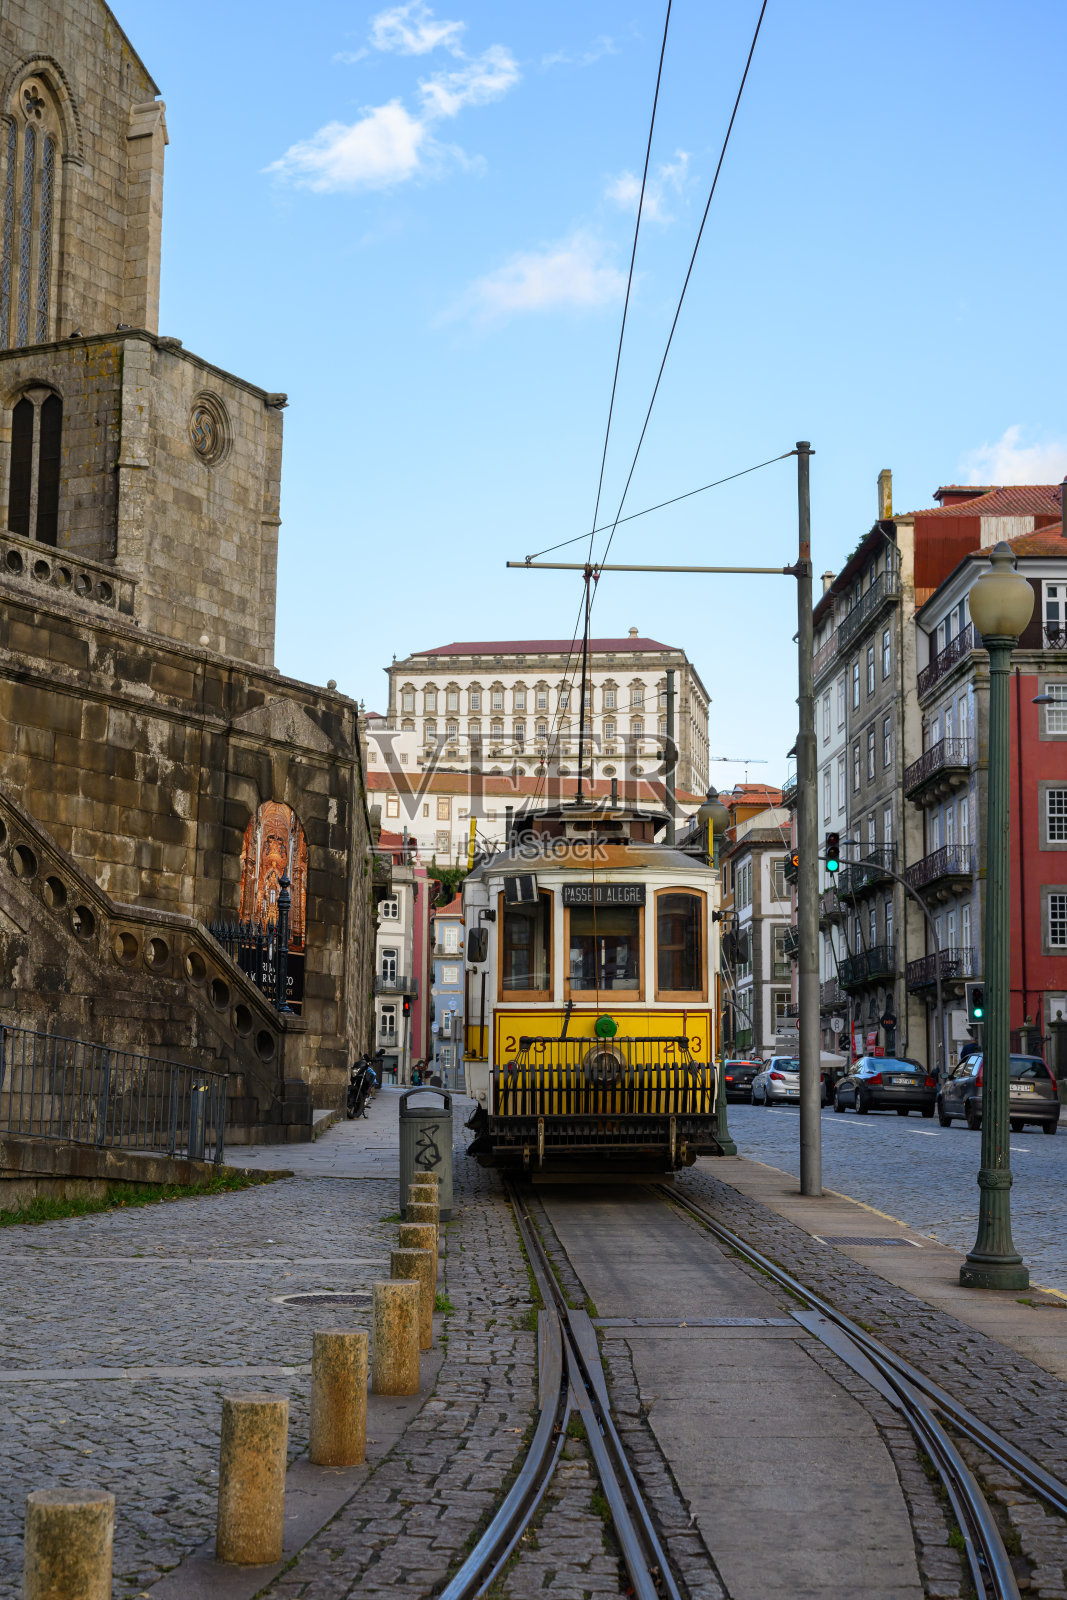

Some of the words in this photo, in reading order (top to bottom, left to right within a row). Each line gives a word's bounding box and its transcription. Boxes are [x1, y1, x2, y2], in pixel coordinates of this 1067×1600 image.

[606, 887, 642, 902] ALEGRE
[505, 1036, 547, 1053] 23
[663, 1036, 702, 1053] 23
